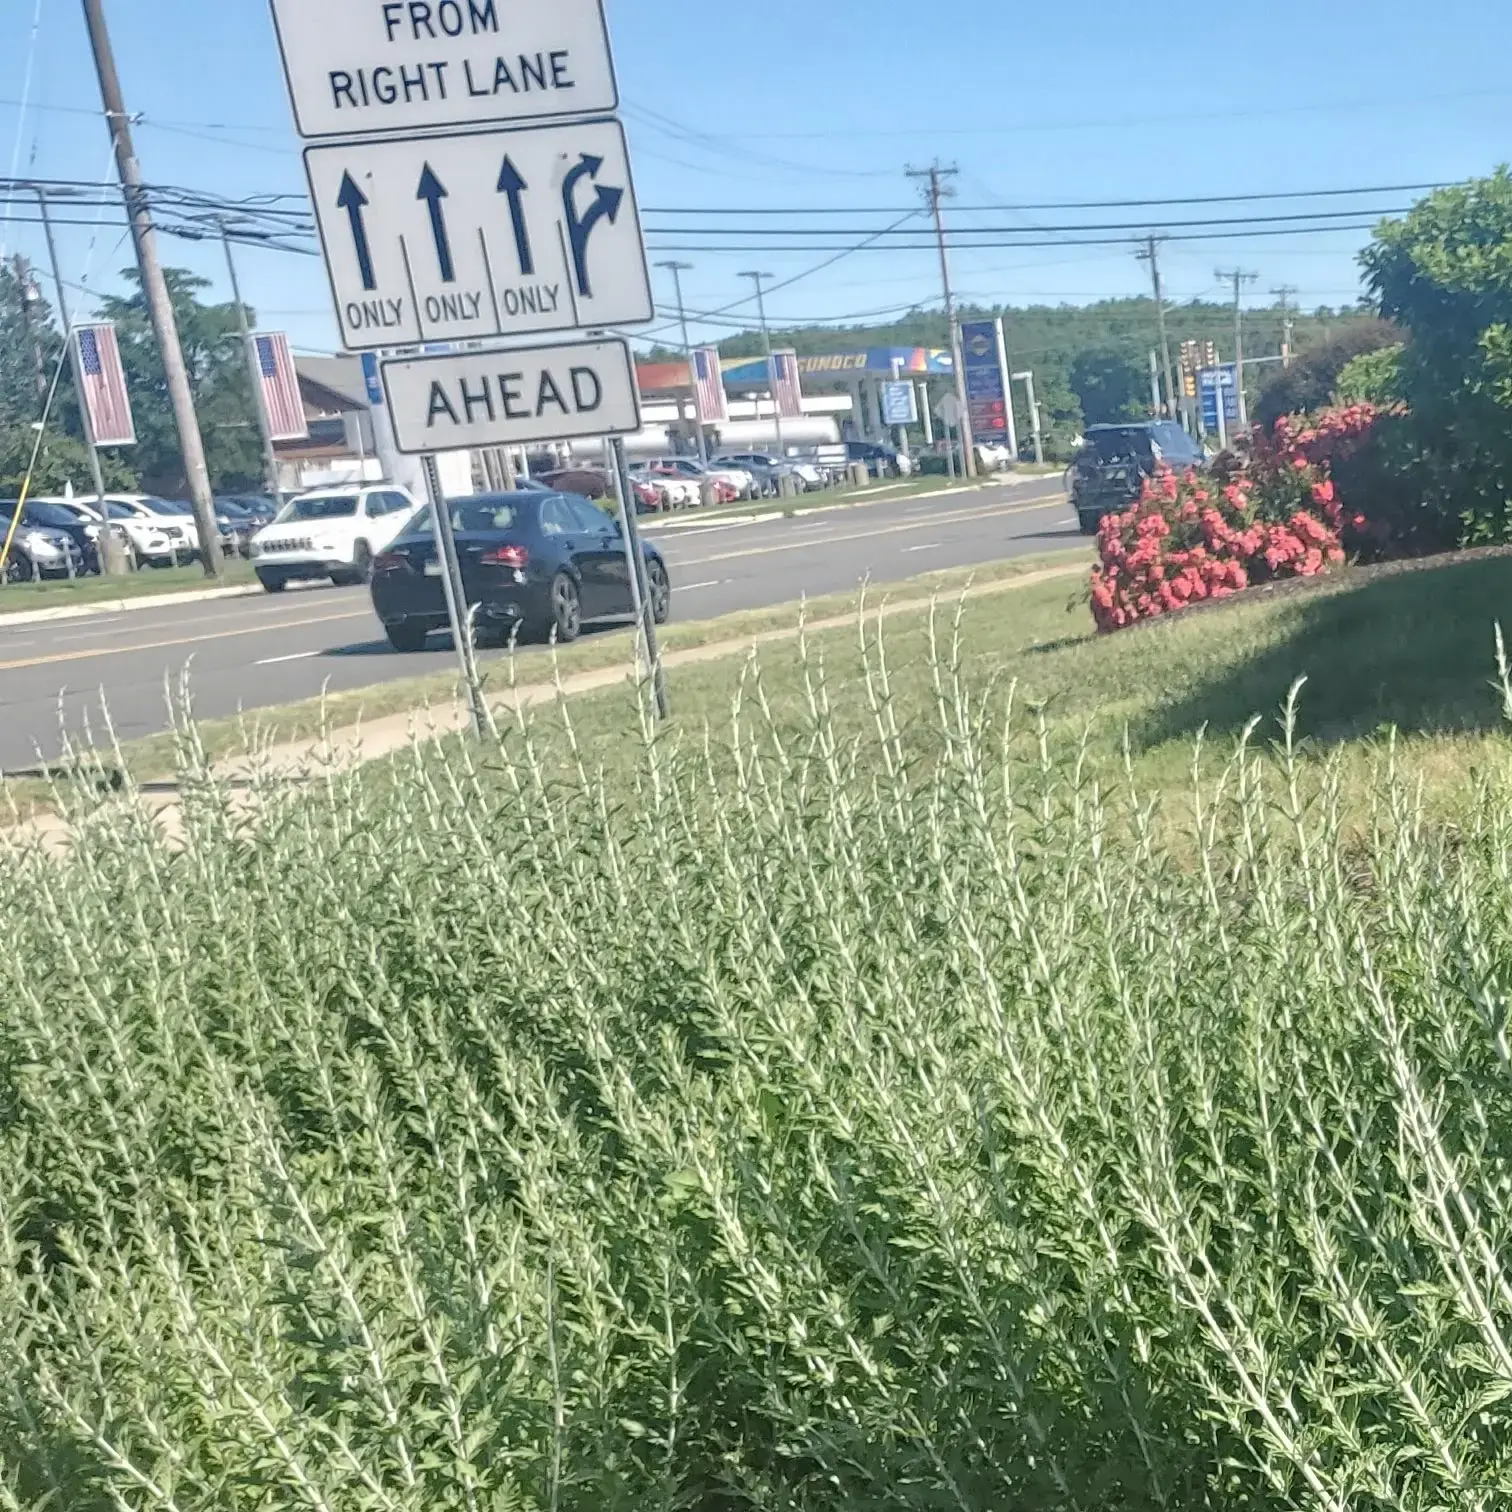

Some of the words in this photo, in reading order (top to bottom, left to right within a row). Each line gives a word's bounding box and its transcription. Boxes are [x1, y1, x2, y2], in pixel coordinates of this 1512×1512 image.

[382, 0, 500, 42] FROM
[328, 61, 448, 109] RIGHT
[463, 50, 575, 97] LANE
[346, 297, 403, 330] ONLY
[425, 291, 481, 324] ONLY
[504, 284, 559, 316] ONLY
[798, 354, 867, 372] SUNOCO
[426, 366, 603, 428] AHEAD
